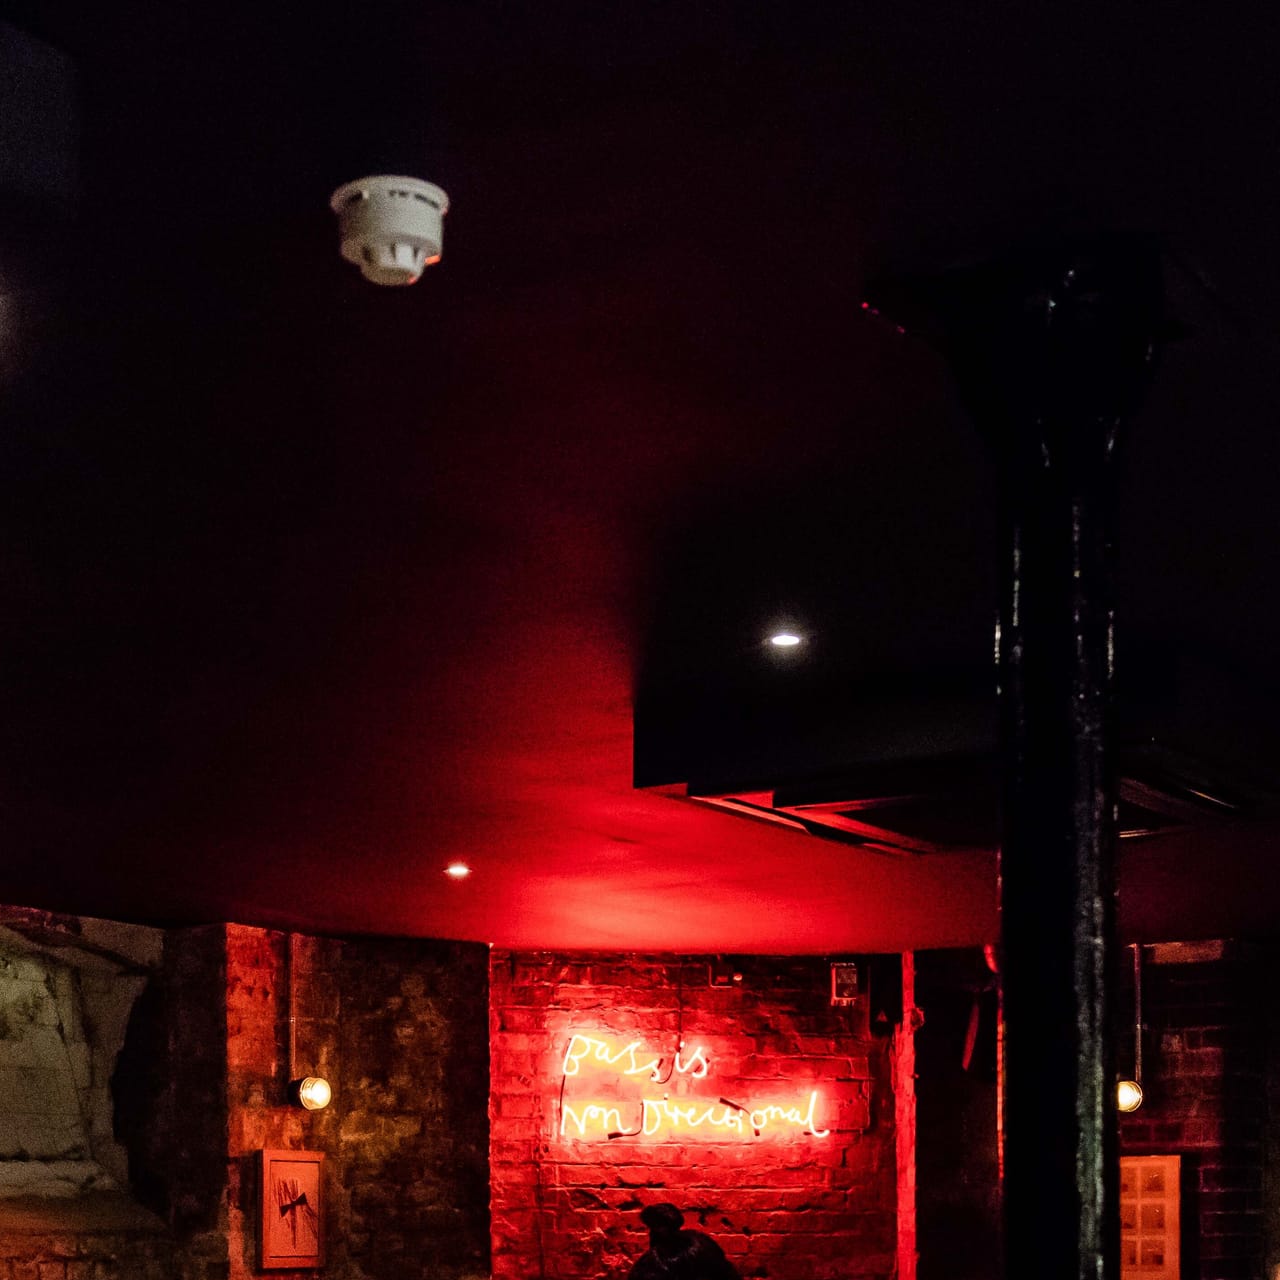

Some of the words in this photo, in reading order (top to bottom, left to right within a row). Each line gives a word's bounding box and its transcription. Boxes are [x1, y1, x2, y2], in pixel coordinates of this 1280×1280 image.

[673, 1040, 710, 1080] is
[560, 1103, 633, 1137] Non
[642, 1090, 831, 1139] Directional
